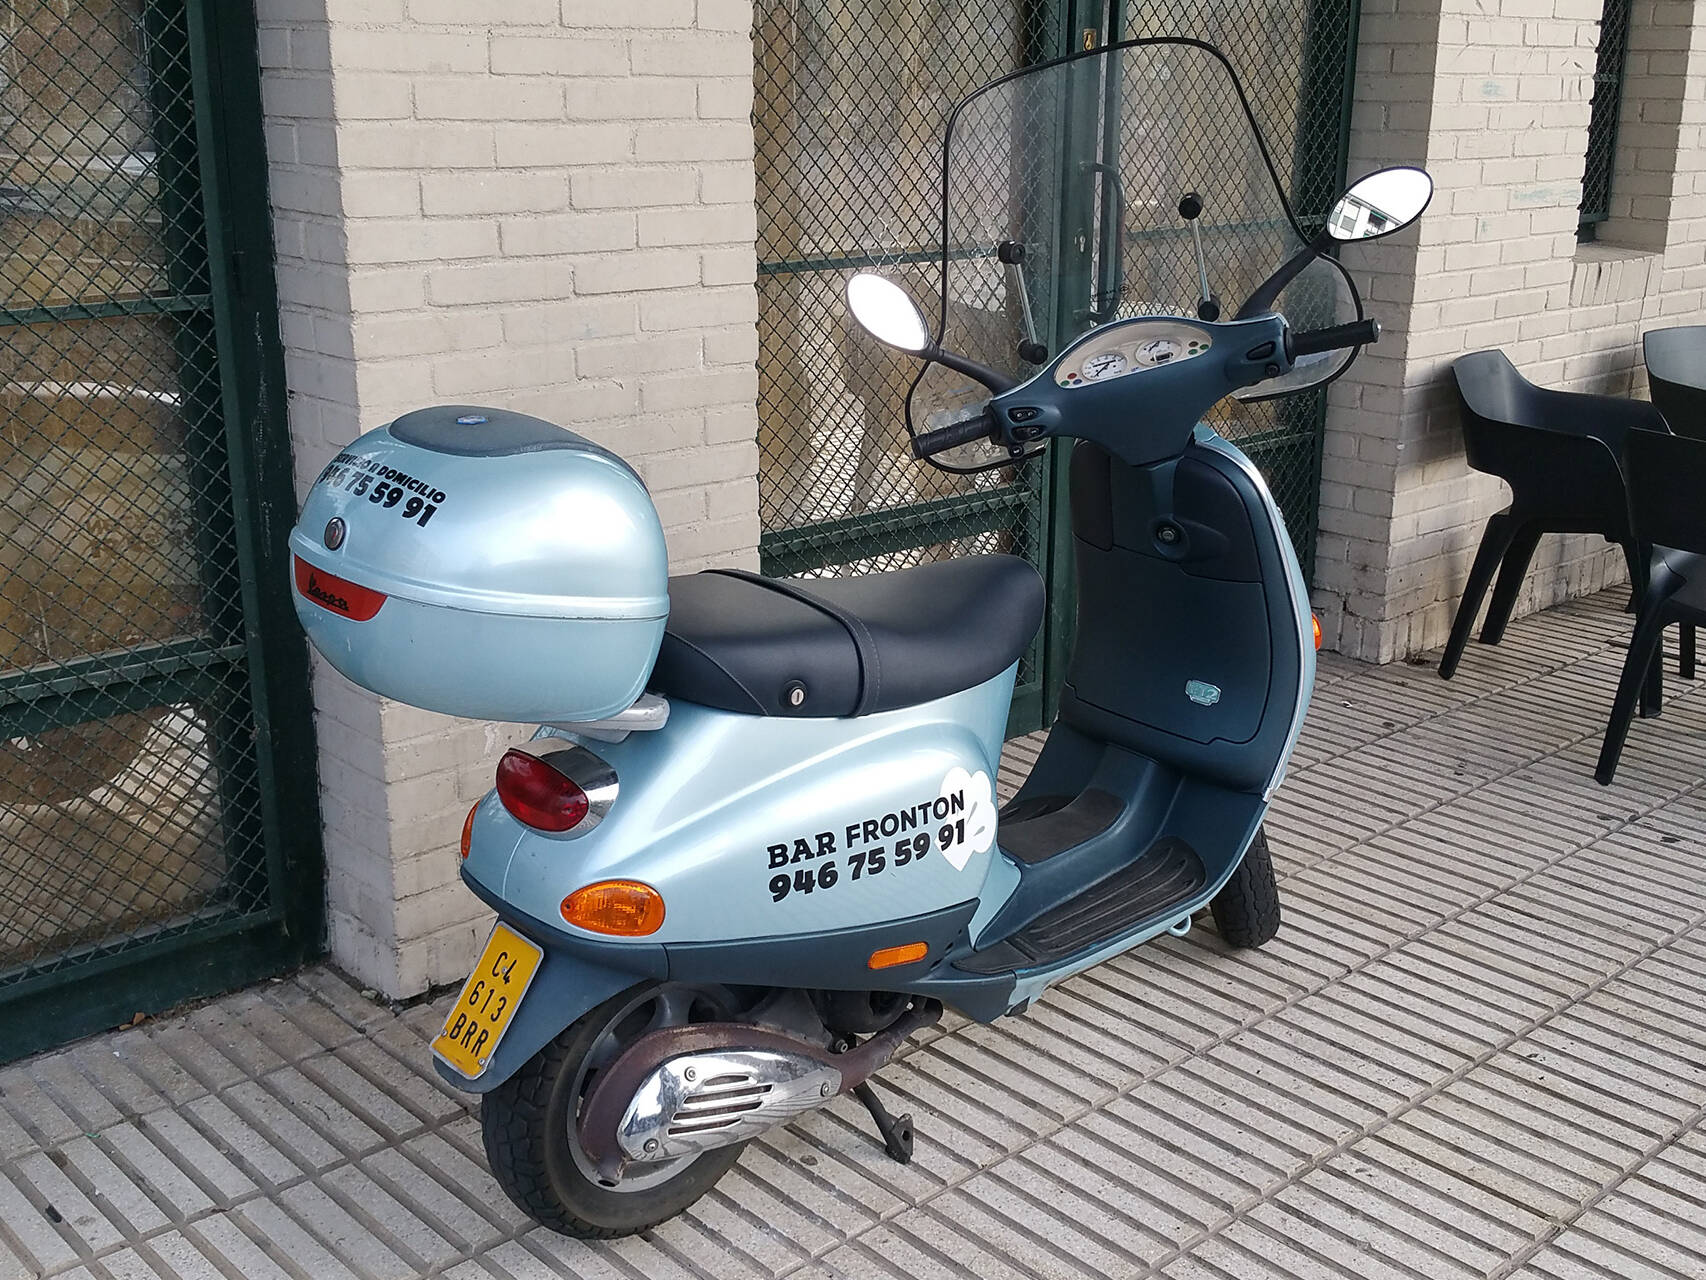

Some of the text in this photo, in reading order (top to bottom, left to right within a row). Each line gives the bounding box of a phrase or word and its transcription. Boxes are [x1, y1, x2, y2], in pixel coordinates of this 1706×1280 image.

[345, 471, 375, 496] 75
[369, 481, 404, 508] 59
[402, 497, 437, 528] 91
[377, 466, 446, 503] DOMICILIO
[767, 789, 965, 869] BAR FRONTON
[769, 819, 965, 903] 946 75 59 91
[491, 951, 518, 985] C4
[468, 980, 507, 1022] 613
[449, 1012, 489, 1057] BRR
